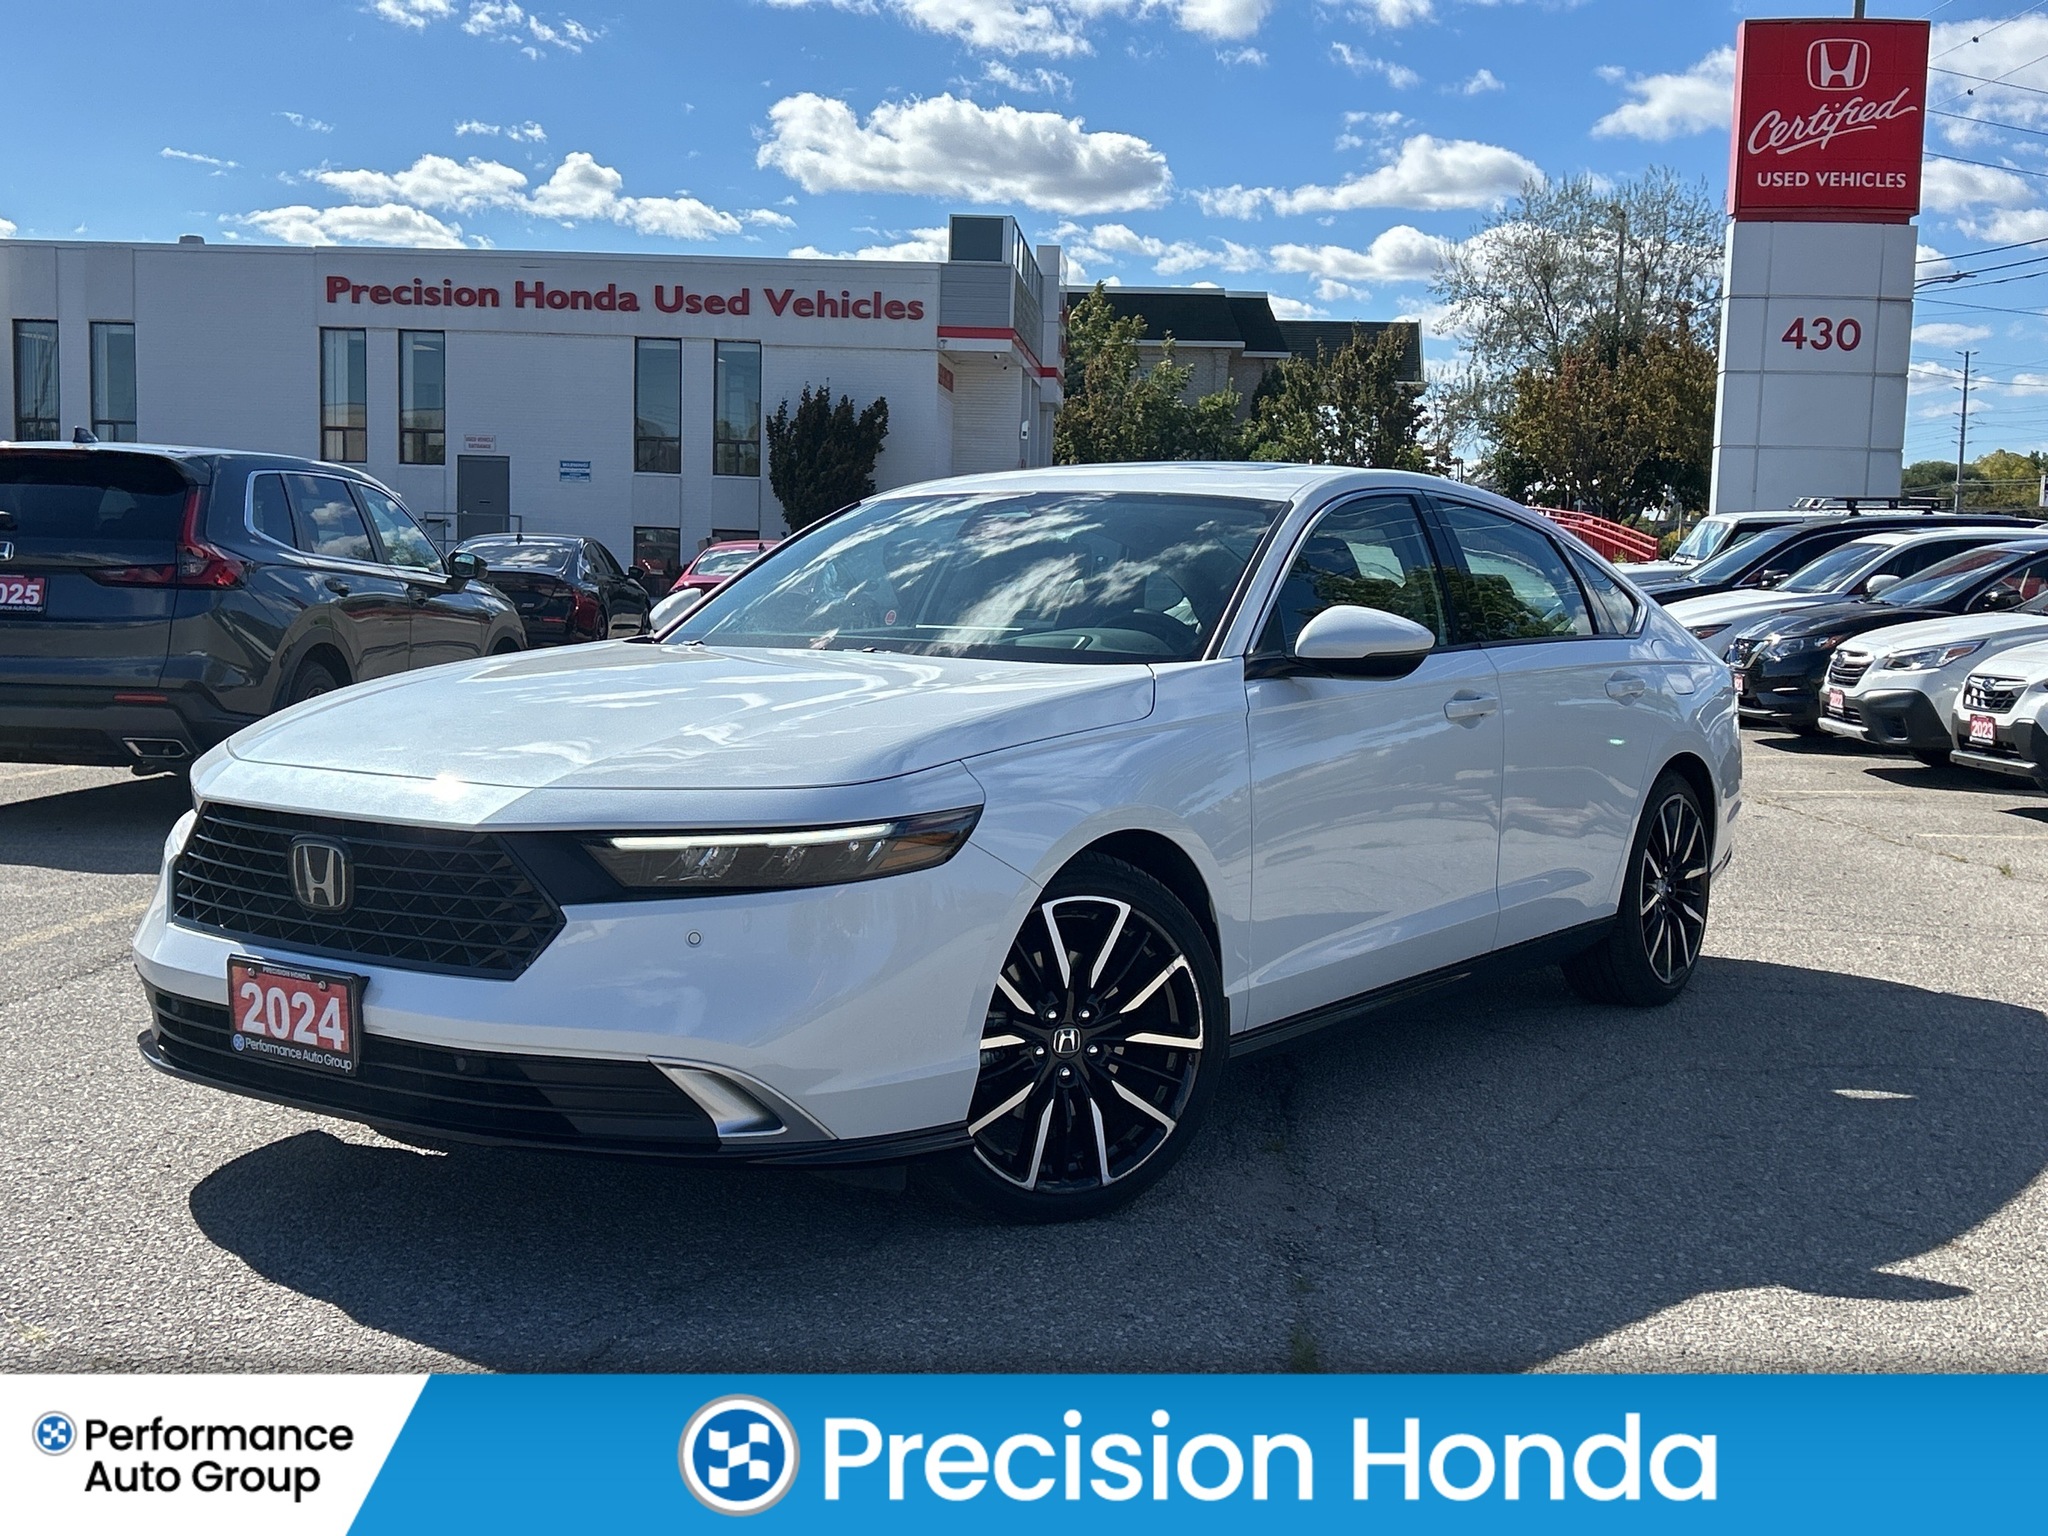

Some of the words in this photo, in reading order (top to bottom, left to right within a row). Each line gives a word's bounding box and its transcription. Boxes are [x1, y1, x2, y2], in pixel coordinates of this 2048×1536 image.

[1747, 87, 1918, 155] Certified
[1757, 171, 1810, 187] USED
[1815, 172, 1907, 189] VEHICLES
[326, 276, 499, 307] Precision
[514, 281, 639, 313] Honda
[655, 286, 750, 315] Used
[763, 290, 924, 321] Vehicles
[1781, 316, 1861, 352] 430
[1971, 719, 1994, 740] 2023
[290, 971, 312, 981] HONDA
[240, 982, 345, 1051] 2024
[245, 1037, 302, 1060] Performance
[302, 1049, 323, 1064] Auto
[324, 1053, 353, 1073] Group
